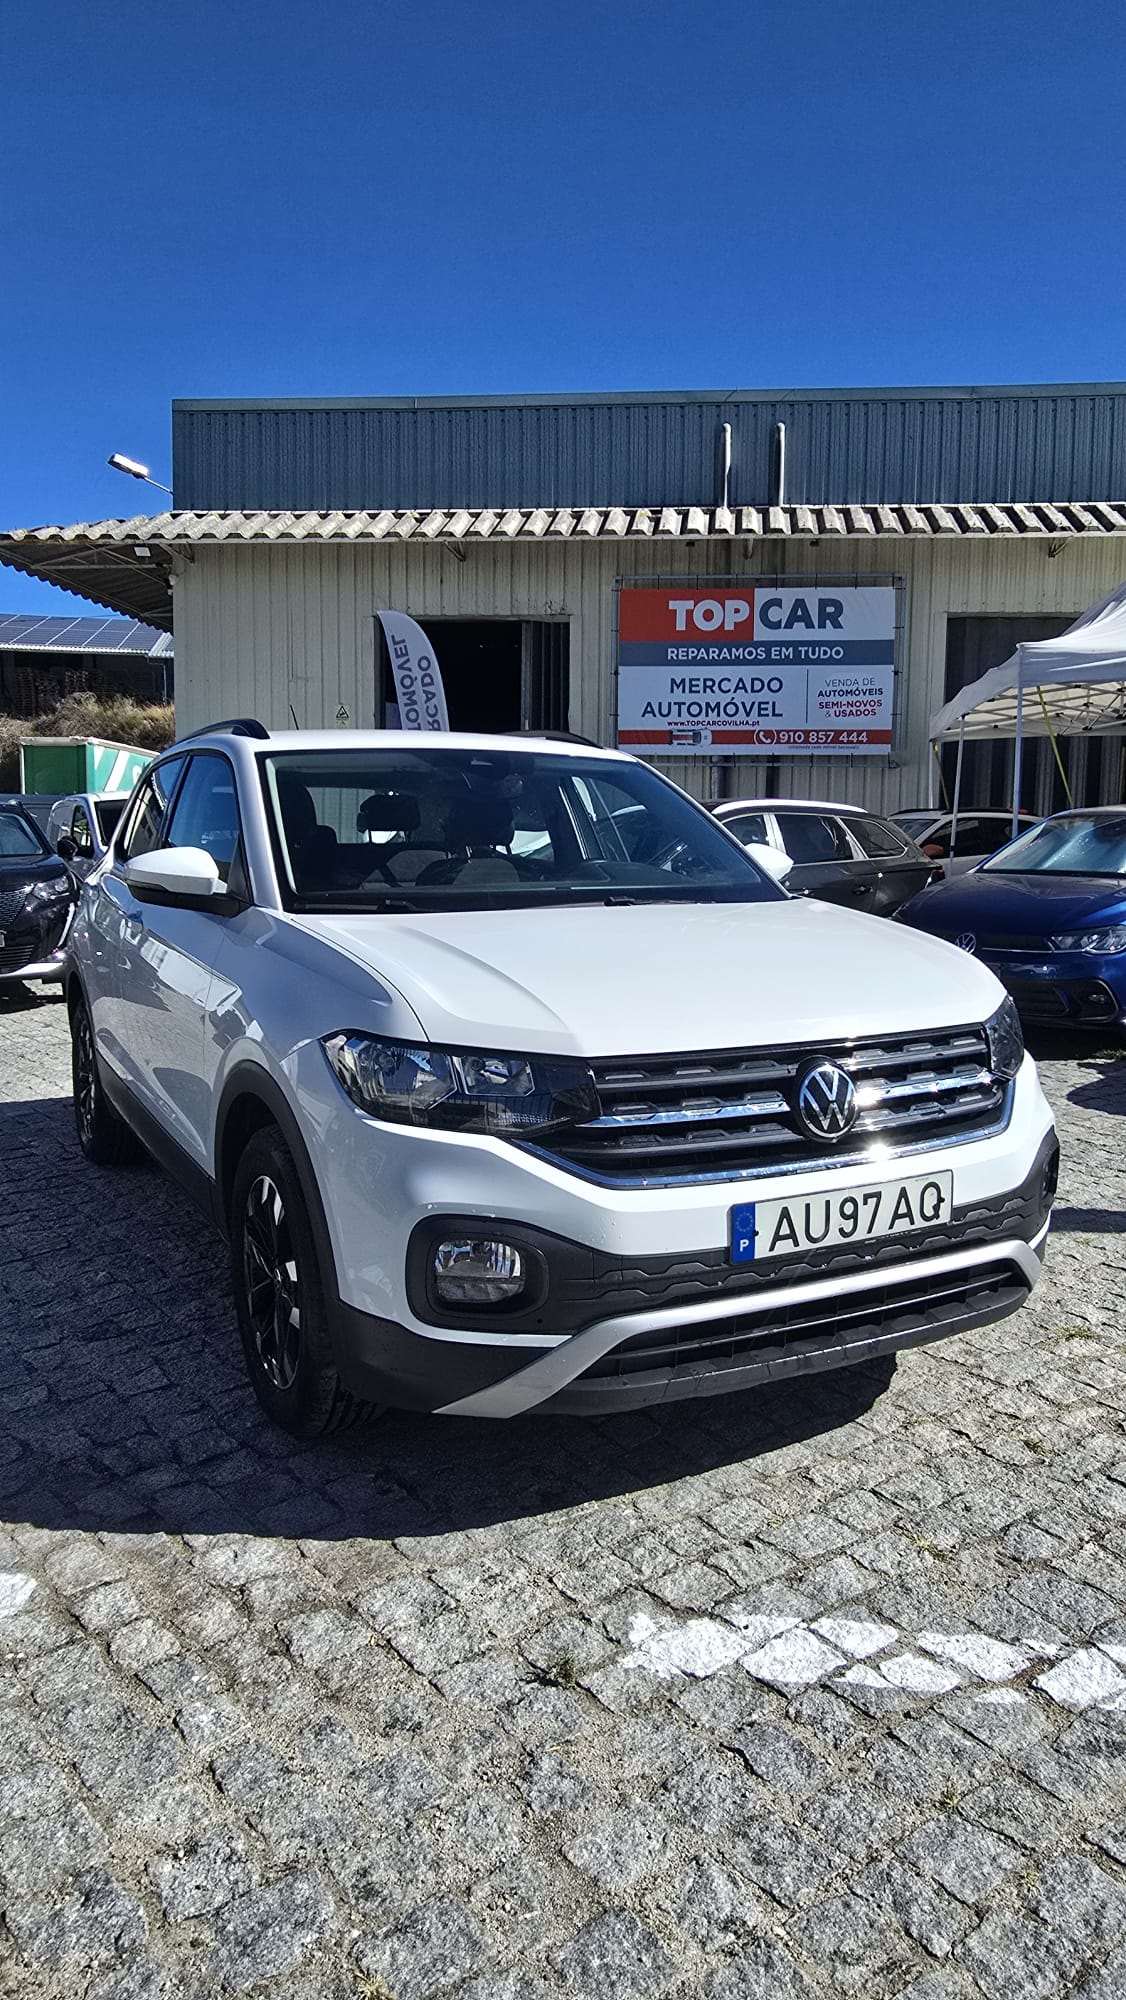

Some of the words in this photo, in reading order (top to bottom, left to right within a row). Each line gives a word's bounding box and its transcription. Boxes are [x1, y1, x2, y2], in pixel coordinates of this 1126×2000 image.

[668, 599, 750, 632] TOP
[758, 597, 845, 630] CAR
[667, 647, 766, 661] REPARAMOS
[771, 647, 793, 660] EM
[798, 646, 844, 659] TUDO
[670, 677, 784, 694] MERCADO
[824, 678, 860, 688] VENDA
[862, 677, 876, 686] DE
[817, 687, 884, 698] AUTOMÓVEIS
[641, 697, 784, 718] AUTOMÓVEL
[818, 699, 883, 710] SEMI-NOVOS
[824, 709, 832, 718] &
[834, 709, 877, 718] USADOS
[667, 720, 760, 728] www.TOPCARCOVILHA.pt
[779, 731, 805, 744] 910
[808, 731, 835, 743] 857
[838, 731, 868, 743] 444
[739, 1239, 749, 1252] P
